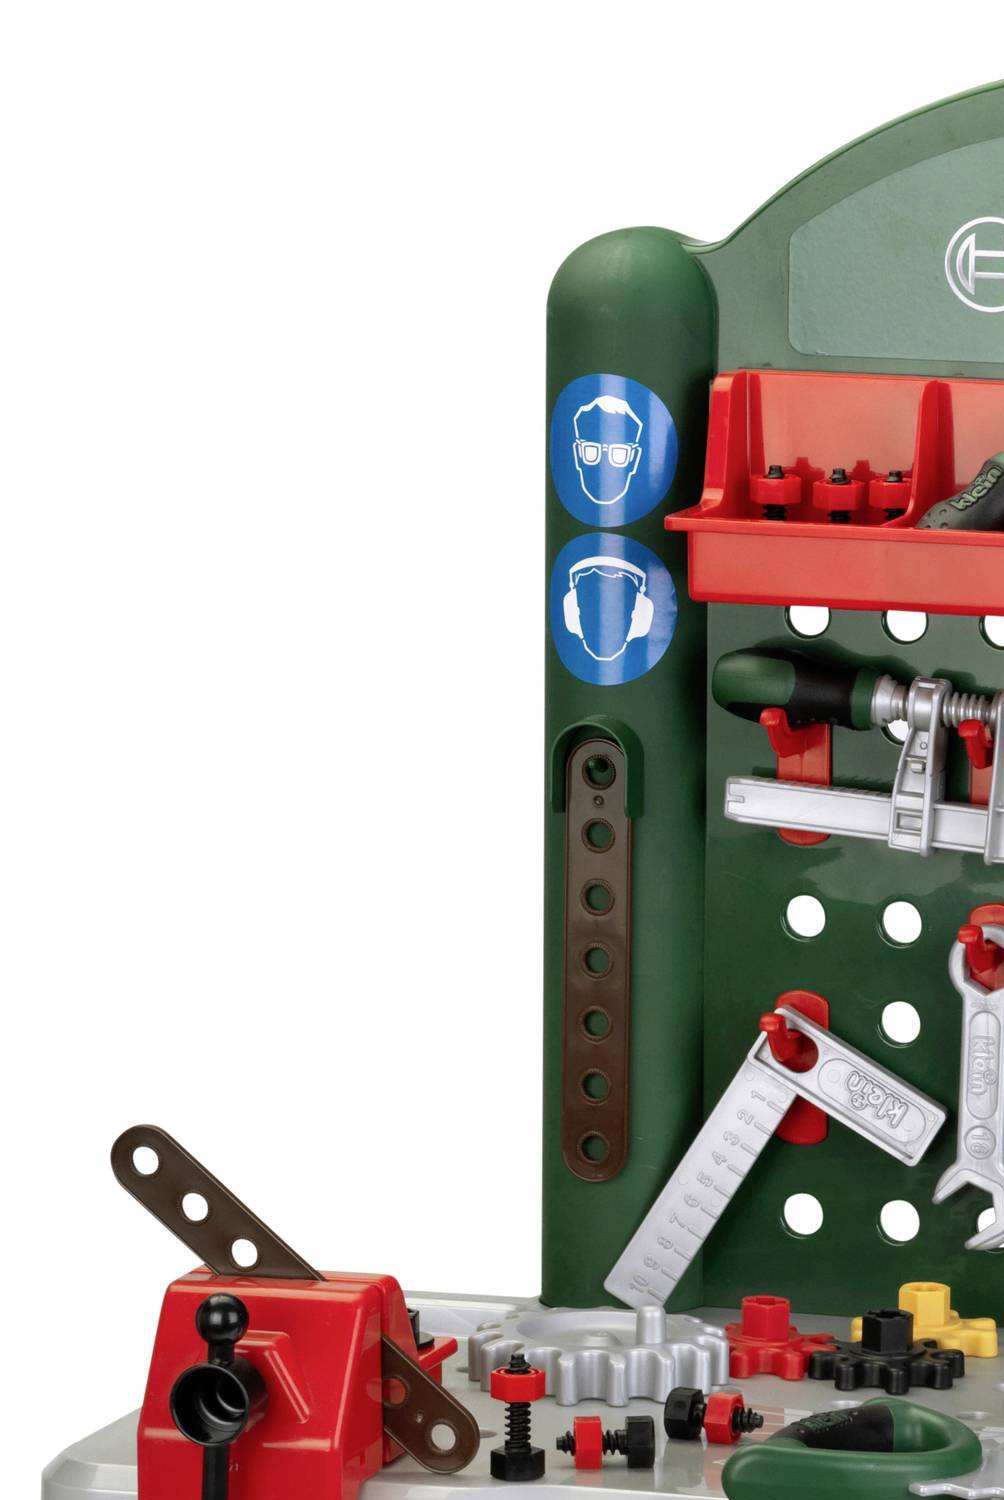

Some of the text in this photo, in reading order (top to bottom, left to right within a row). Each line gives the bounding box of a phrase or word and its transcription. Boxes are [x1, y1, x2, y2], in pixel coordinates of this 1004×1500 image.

[948, 464, 1004, 511] klein
[967, 1034, 998, 1096] klein
[846, 1070, 909, 1129] klein
[736, 1108, 754, 1126] 2
[723, 1131, 740, 1146] 3
[711, 1151, 727, 1166] 4
[696, 1171, 713, 1188] 5
[683, 1193, 700, 1208] 6
[670, 1213, 685, 1228] 7
[643, 1257, 661, 1271] 9
